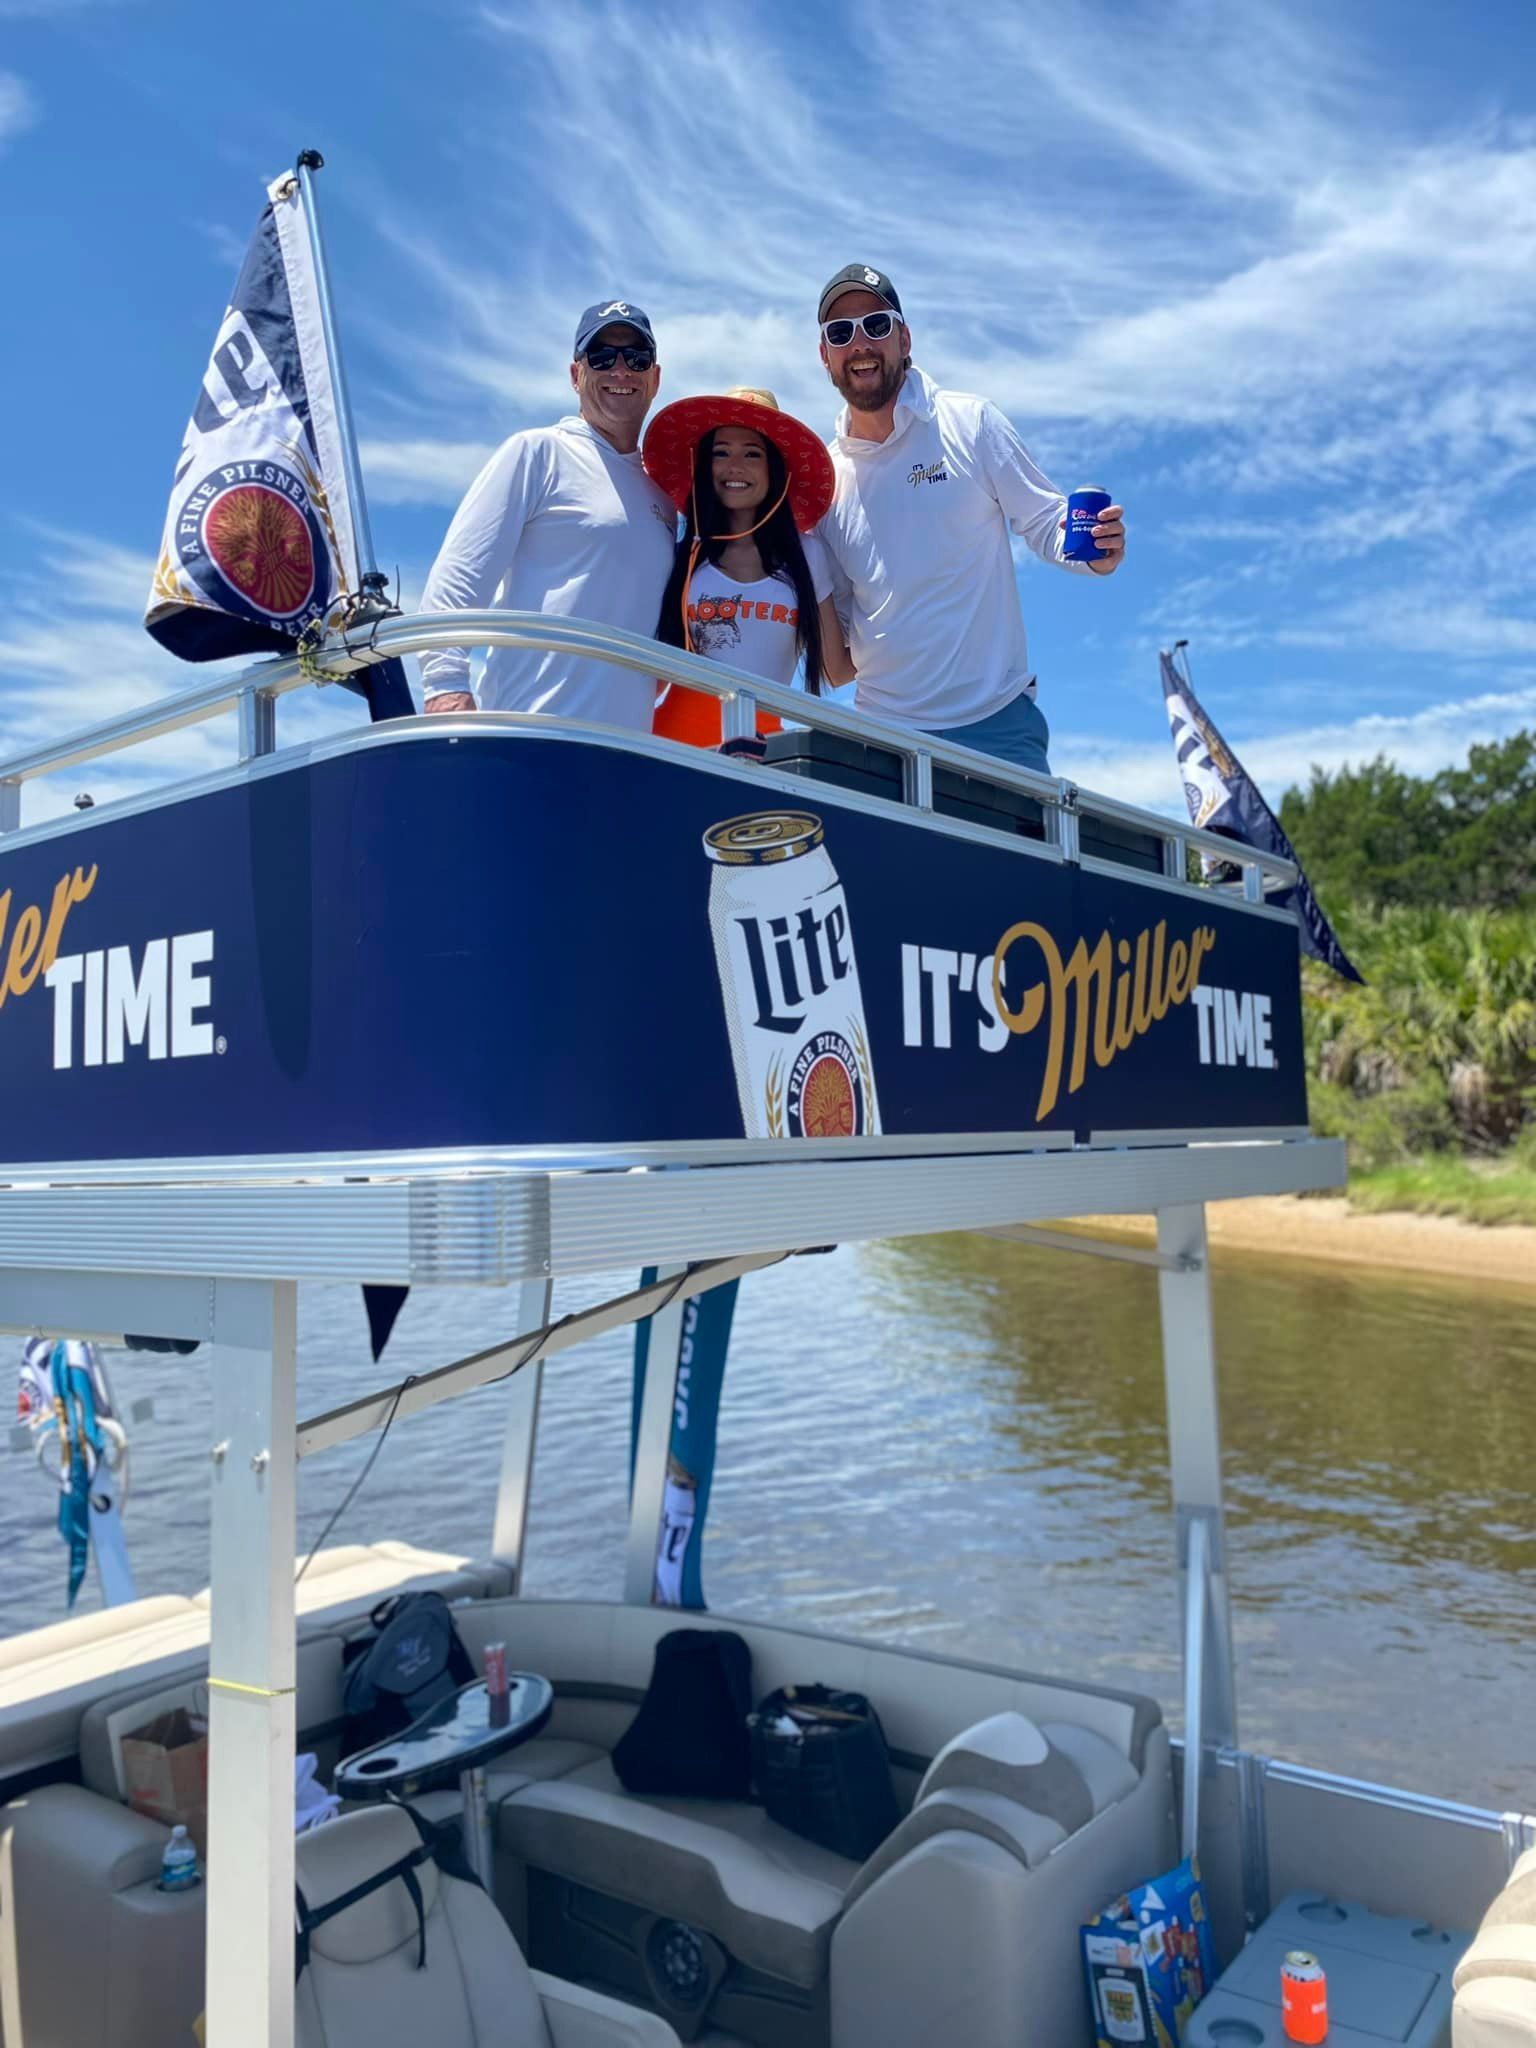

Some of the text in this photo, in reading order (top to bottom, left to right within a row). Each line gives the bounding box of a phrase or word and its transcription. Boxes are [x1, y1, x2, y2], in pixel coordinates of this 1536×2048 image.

[220, 463, 312, 515] PILSNER
[906, 460, 946, 488] Miller
[928, 472, 948, 484] TIME
[180, 482, 218, 535] FINE
[182, 540, 200, 555] A
[45, 929, 214, 1069] TIME
[733, 903, 850, 1035] Lite
[901, 919, 1276, 1123] IT'S Miller TIME
[788, 1034, 859, 1117] A FINE PILSNER
